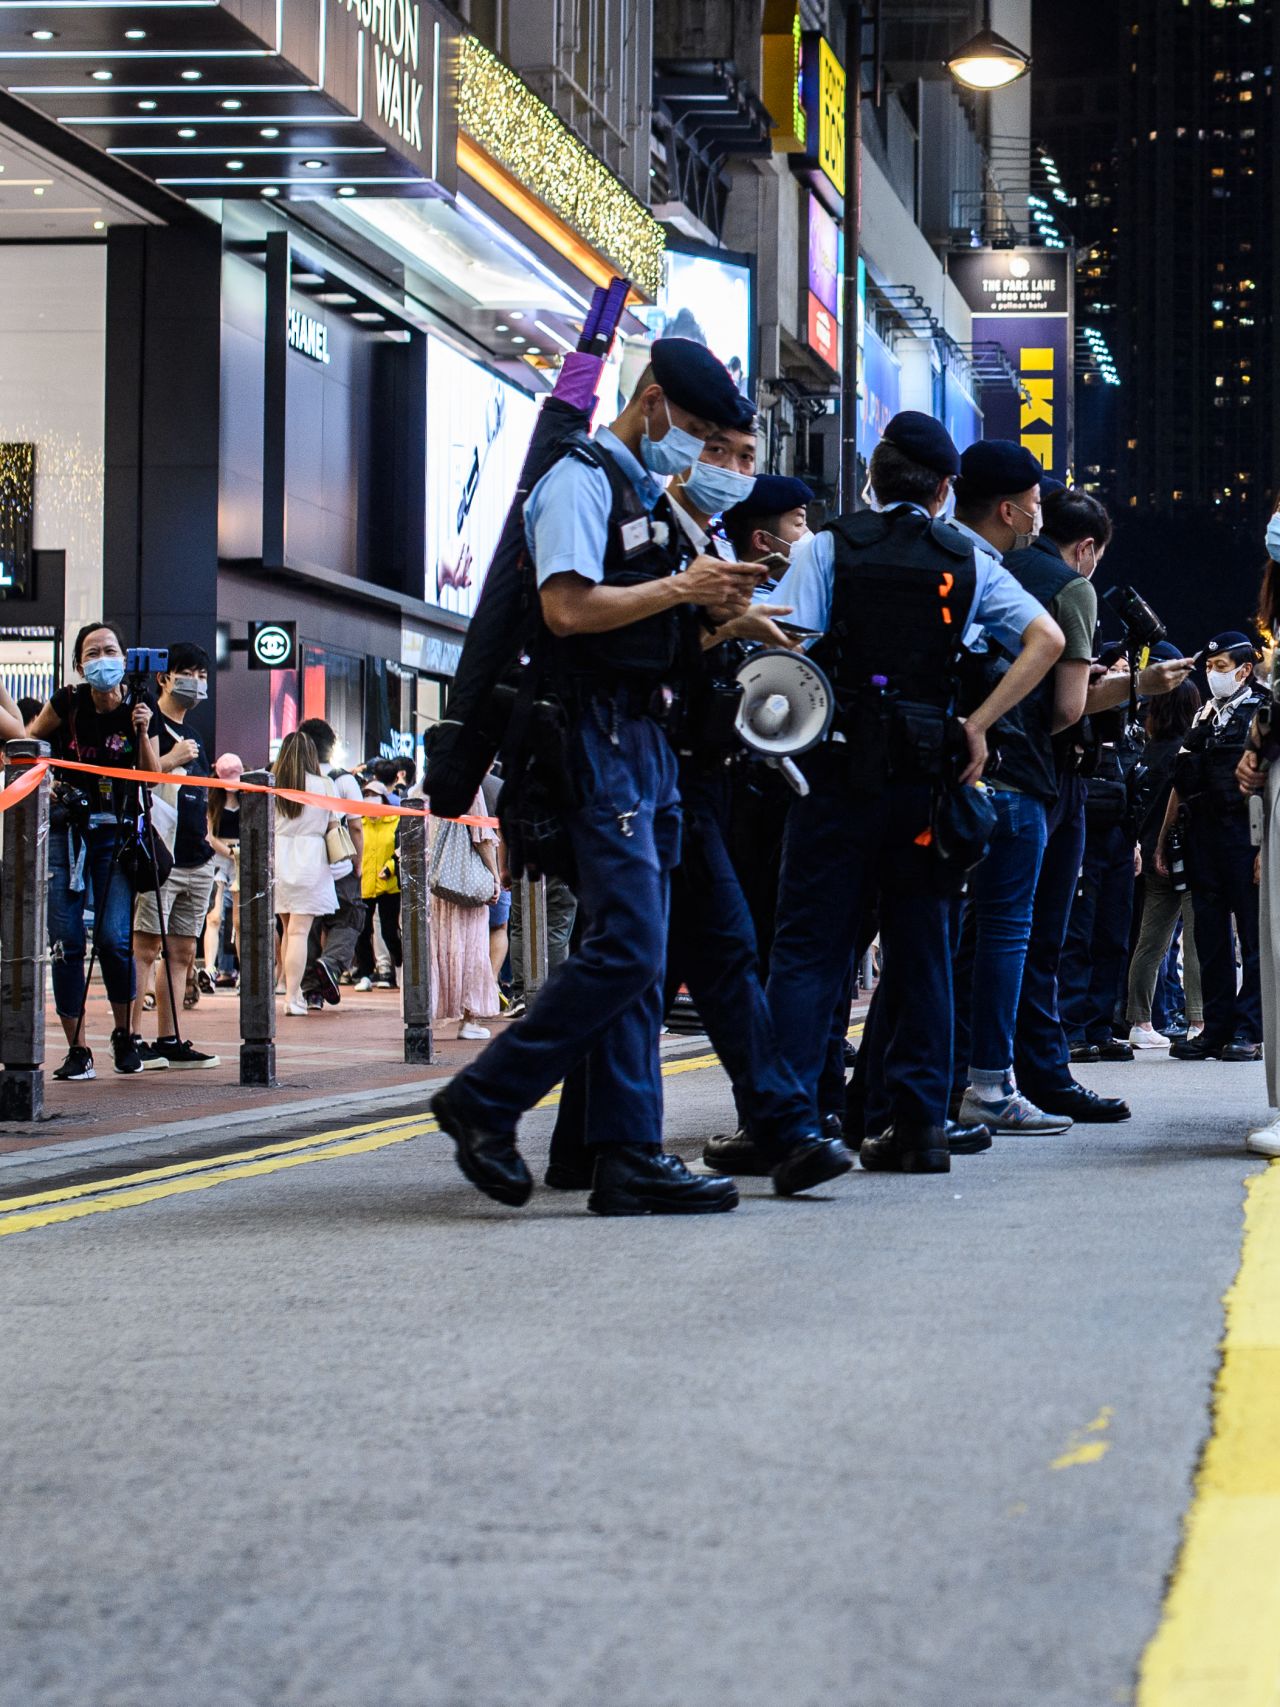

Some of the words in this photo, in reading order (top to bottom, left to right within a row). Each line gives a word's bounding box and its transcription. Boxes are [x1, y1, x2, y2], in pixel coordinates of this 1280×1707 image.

[374, 44, 423, 152] WALK
[983, 280, 1001, 292] THE
[1003, 280, 1029, 292] PARK
[1031, 280, 1056, 292] LANE
[1020, 347, 1054, 471] IKE
